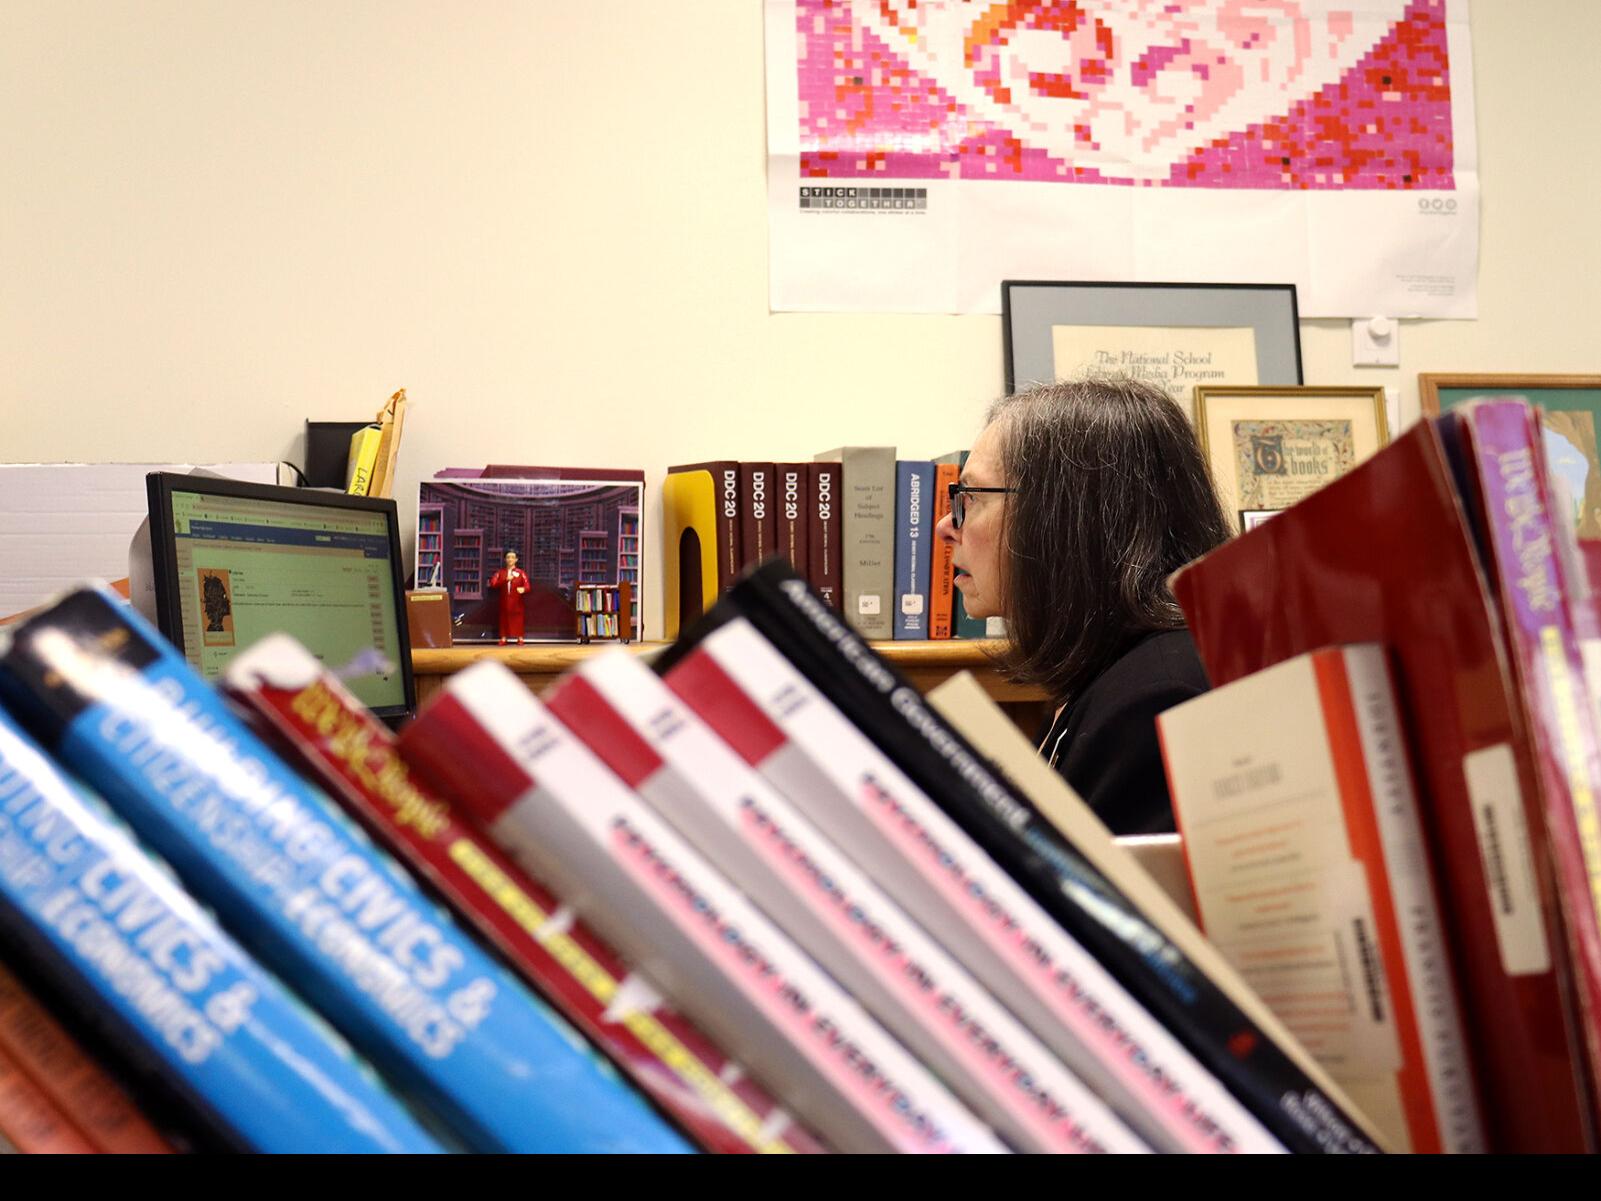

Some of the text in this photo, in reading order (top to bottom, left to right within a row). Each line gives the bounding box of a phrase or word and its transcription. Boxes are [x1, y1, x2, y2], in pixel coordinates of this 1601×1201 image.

[801, 188, 857, 197] STICK
[824, 199, 914, 208] TOGETHER
[1096, 350, 1212, 365] The National School
[1171, 365, 1225, 382] Program
[1290, 456, 1328, 475] books
[724, 470, 736, 518] DDC 20
[753, 472, 765, 519] DDC 20
[785, 473, 798, 519] DDC 20
[818, 473, 831, 520] DDC 20
[909, 473, 921, 538] ABRIDGED 13
[859, 560, 881, 568] Miller
[779, 578, 1032, 829] American Government
[80, 858, 226, 993] CIVICS
[203, 978, 260, 1036] &
[321, 853, 465, 989] CIVICS
[445, 976, 497, 1028] &
[862, 770, 1019, 930] PSYCHOLOGY
[1023, 933, 1054, 966] IN
[1053, 967, 1182, 1095] EVERYDAY
[284, 888, 467, 1058] ECONOMICS
[612, 816, 948, 1142] PSYCHOLOGY IN EVERYDAY
[741, 796, 900, 954] PSYCHOLOGY
[902, 958, 937, 993] IN
[936, 993, 1068, 1120] EVERYDAY
